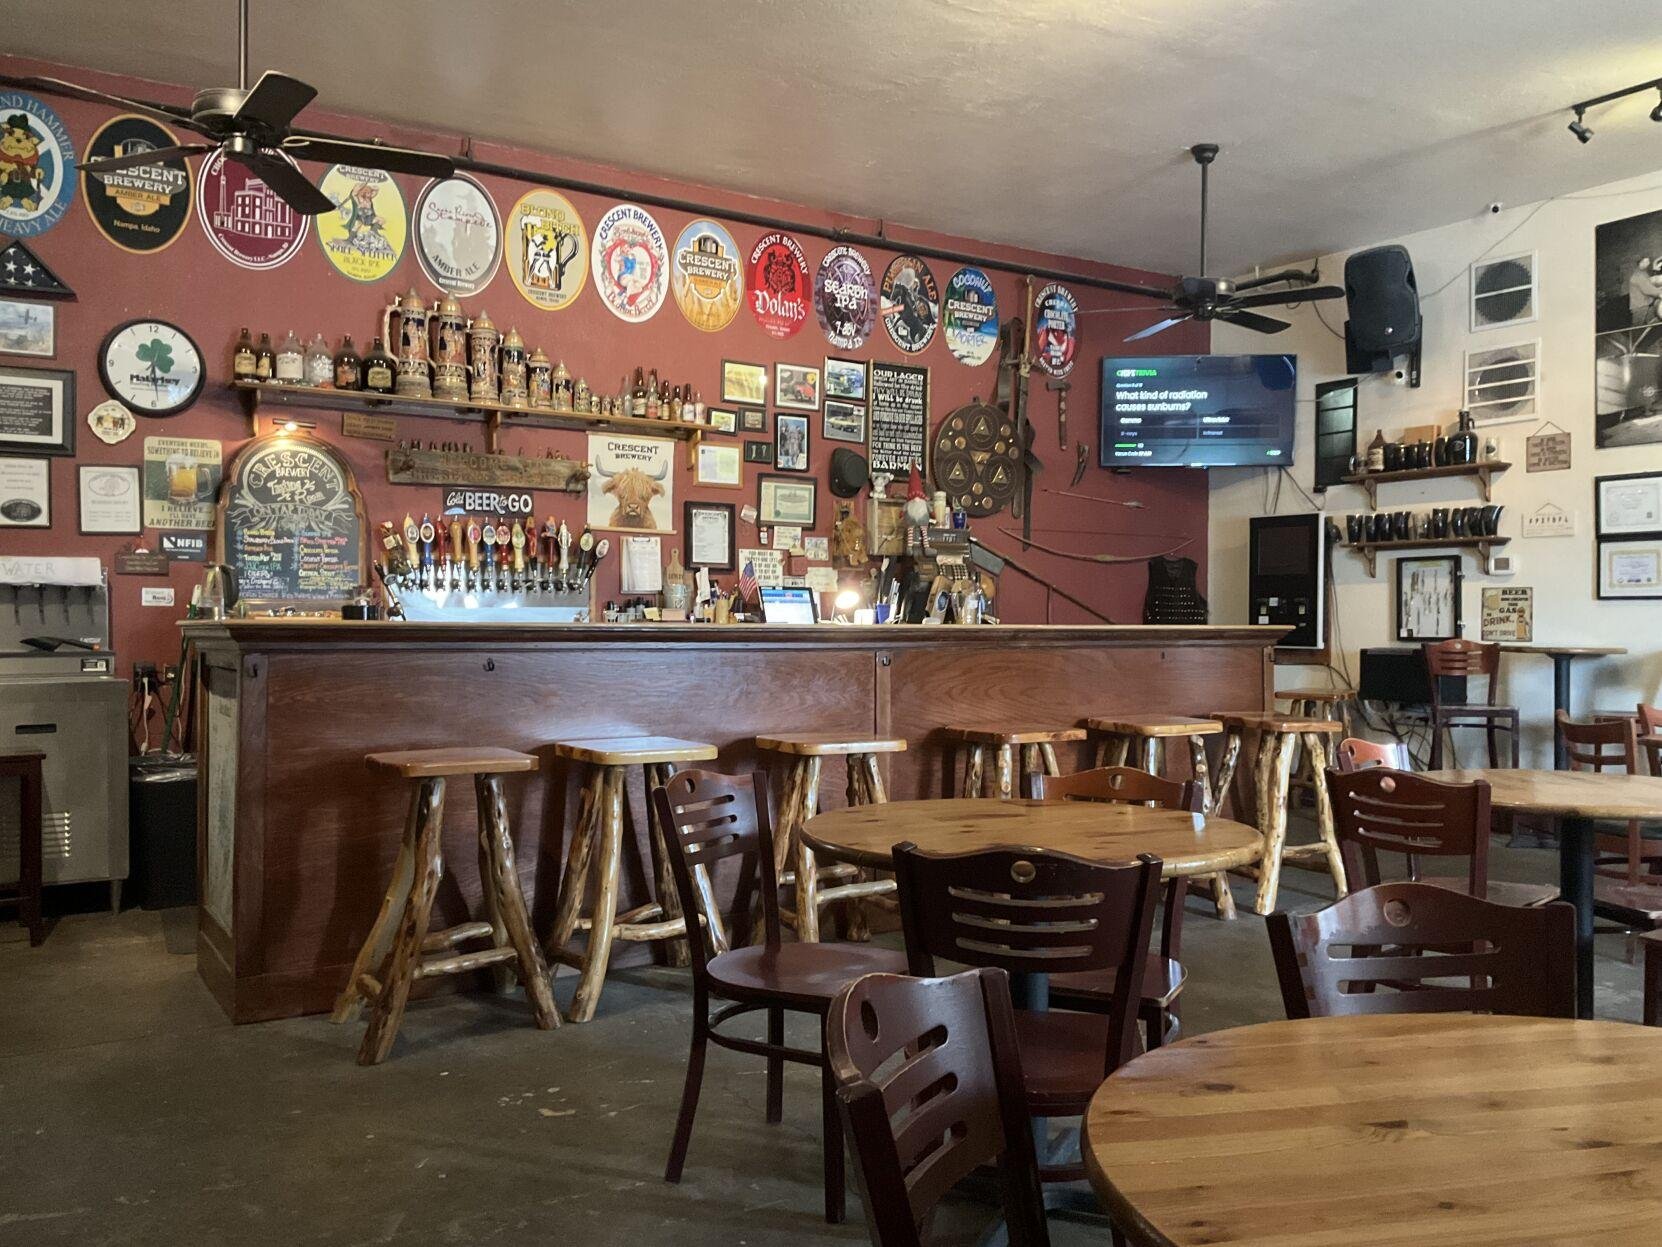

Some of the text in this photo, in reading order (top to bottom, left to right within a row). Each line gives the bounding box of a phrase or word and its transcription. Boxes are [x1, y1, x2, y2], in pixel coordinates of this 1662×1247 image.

[27, 100, 74, 160] HAMMER
[340, 165, 385, 179] CRESCENT
[103, 174, 173, 194] BREWERY
[45, 203, 67, 227] ALE
[600, 208, 664, 252] CRESCENT BREWERY
[751, 234, 809, 275] CRESCENT BREWERY
[432, 254, 480, 277] AMBER ALE
[679, 251, 737, 273] CRESCENT
[687, 265, 730, 280] BREWERY
[922, 275, 937, 300] ALE
[953, 274, 993, 293] COCONUT
[754, 289, 806, 321] Dolan's
[947, 299, 994, 316] CRESCENT
[954, 310, 987, 323] BREWERY
[149, 325, 159, 333] 12
[108, 359, 114, 367] 9
[191, 366, 197, 374] 3
[874, 369, 894, 378] OUR
[894, 371, 924, 381] LAGER
[878, 393, 894, 402] WILL
[895, 395, 903, 403] be
[905, 395, 922, 404] drunk
[1116, 390, 1208, 400] What kind of radiation
[1116, 402, 1192, 412] causes sunburns?
[607, 441, 659, 455] CRESCENT
[615, 453, 652, 462] BREWERY
[248, 451, 340, 492] CRESCENT
[275, 467, 310, 477] BREWERY
[277, 505, 295, 515] TAP
[446, 491, 533, 515] Cold BEER to GO
[149, 518, 193, 527] ANOTHER
[176, 538, 203, 548] NFIB
[2, 562, 56, 577] WATER
